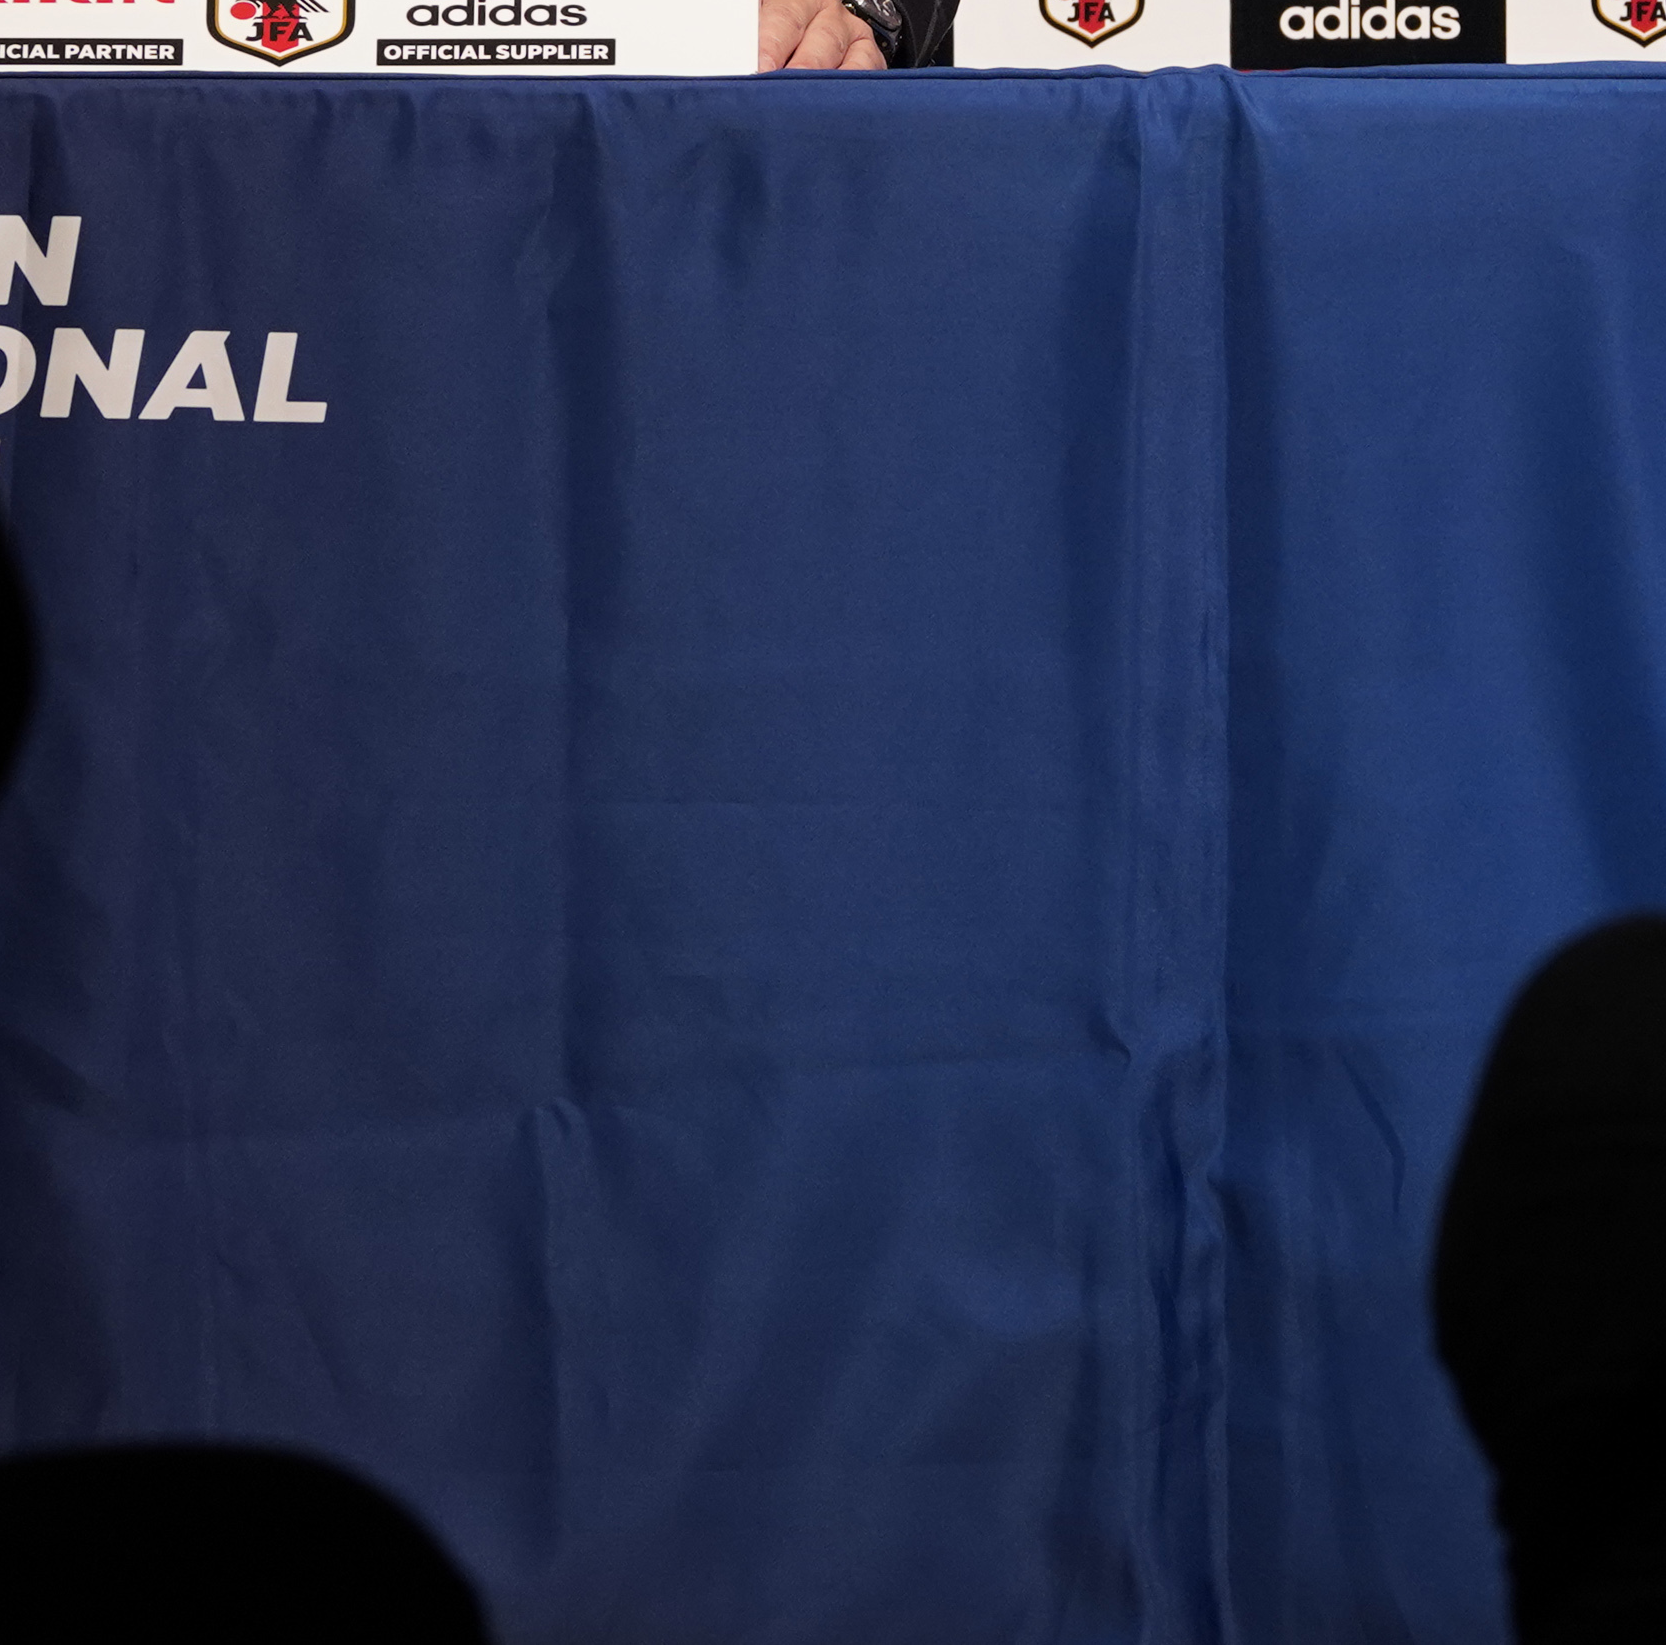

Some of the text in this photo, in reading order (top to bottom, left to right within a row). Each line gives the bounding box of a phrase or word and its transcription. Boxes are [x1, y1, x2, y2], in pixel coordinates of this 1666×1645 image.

[245, 23, 314, 42] JFA
[64, 43, 175, 60] PARTNER
[383, 44, 609, 60] OFFICIAL SUPPLIER
